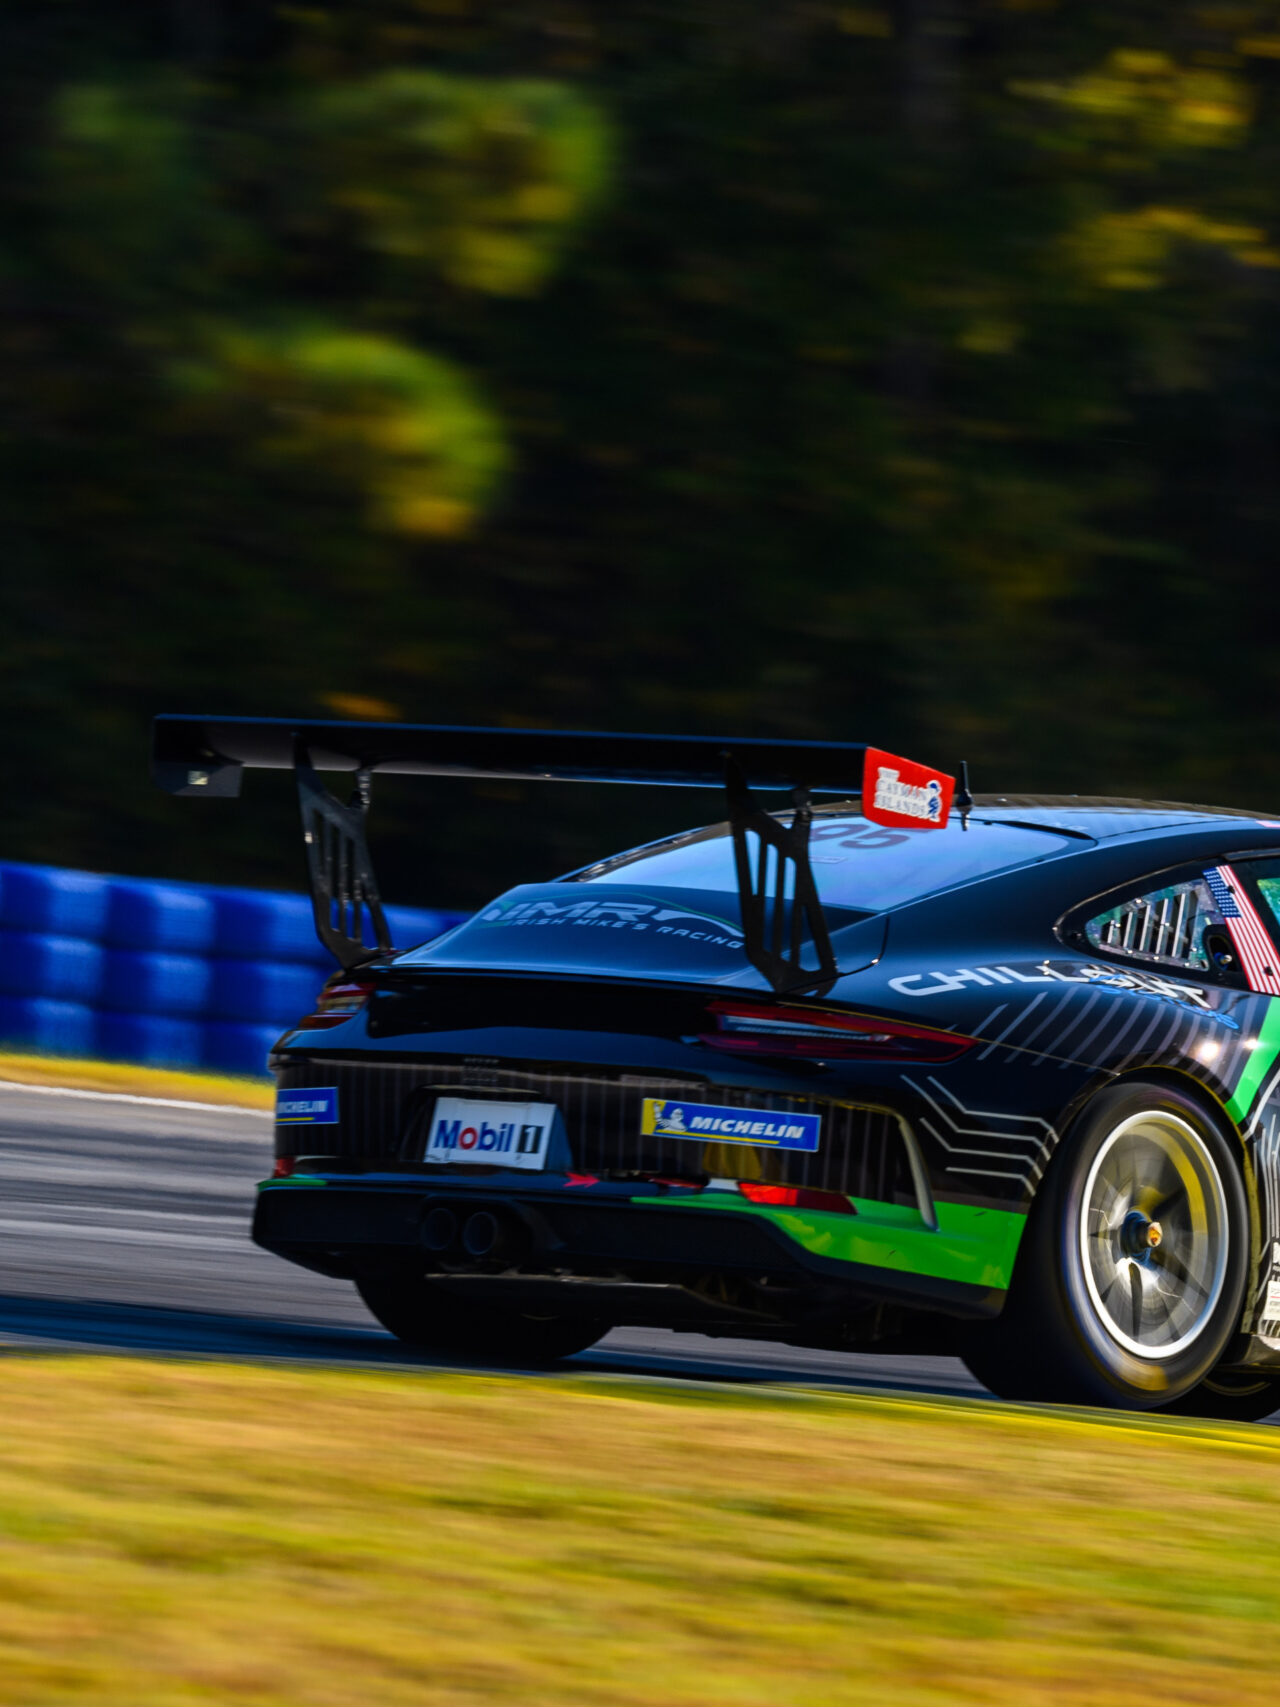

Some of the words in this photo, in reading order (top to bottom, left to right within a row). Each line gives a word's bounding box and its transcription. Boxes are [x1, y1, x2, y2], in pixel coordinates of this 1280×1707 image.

[572, 918, 650, 931] MIKE'S
[656, 926, 744, 949] RACING
[434, 1119, 515, 1152] Mobil
[690, 1116, 804, 1139] MICHELIN
